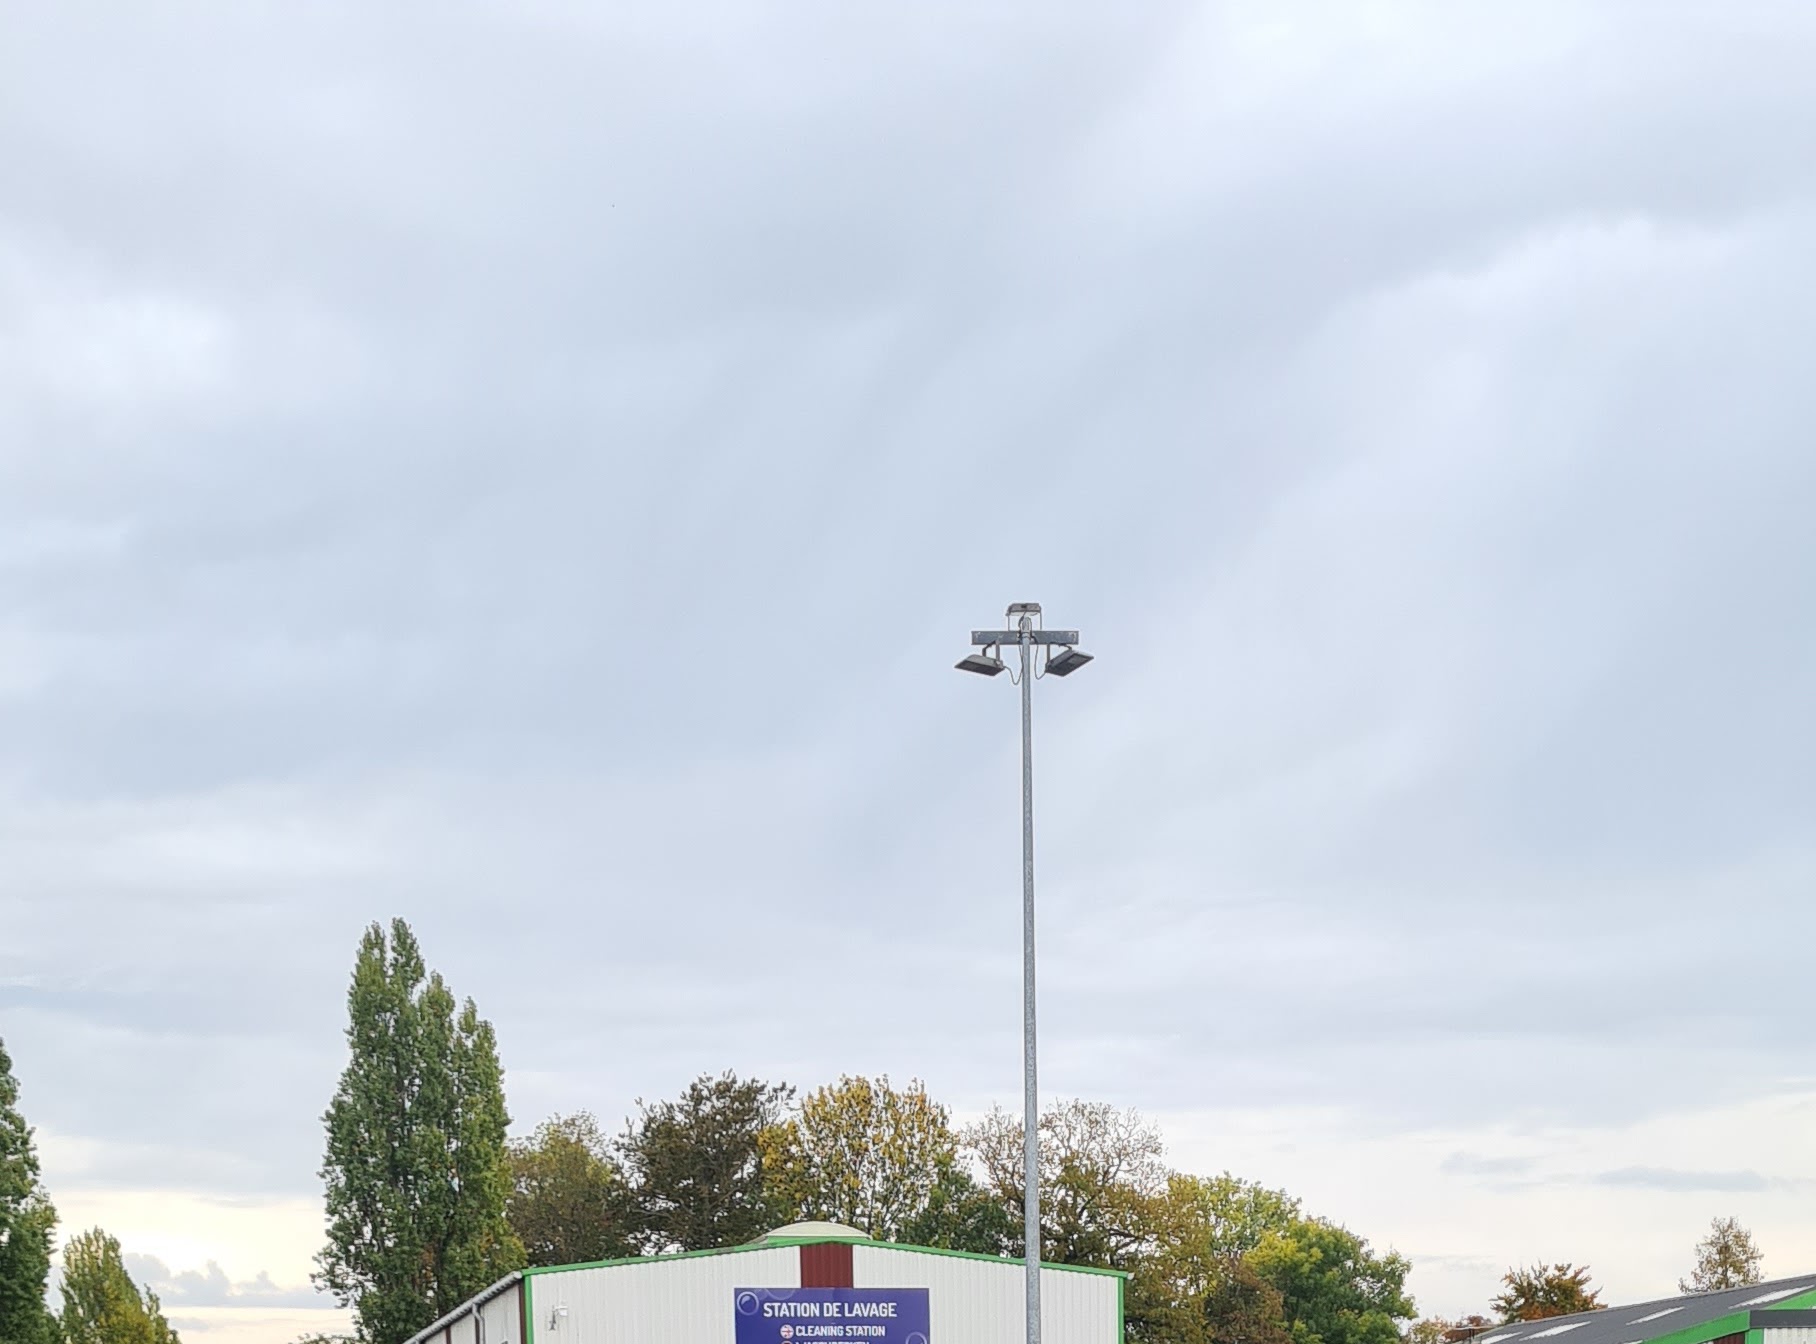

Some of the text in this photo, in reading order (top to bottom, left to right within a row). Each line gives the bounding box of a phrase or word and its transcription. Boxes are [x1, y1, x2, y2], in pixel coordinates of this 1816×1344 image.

[763, 1302, 898, 1318] STATION DE LAVAGE
[795, 1325, 886, 1337] CLEANING STATION
